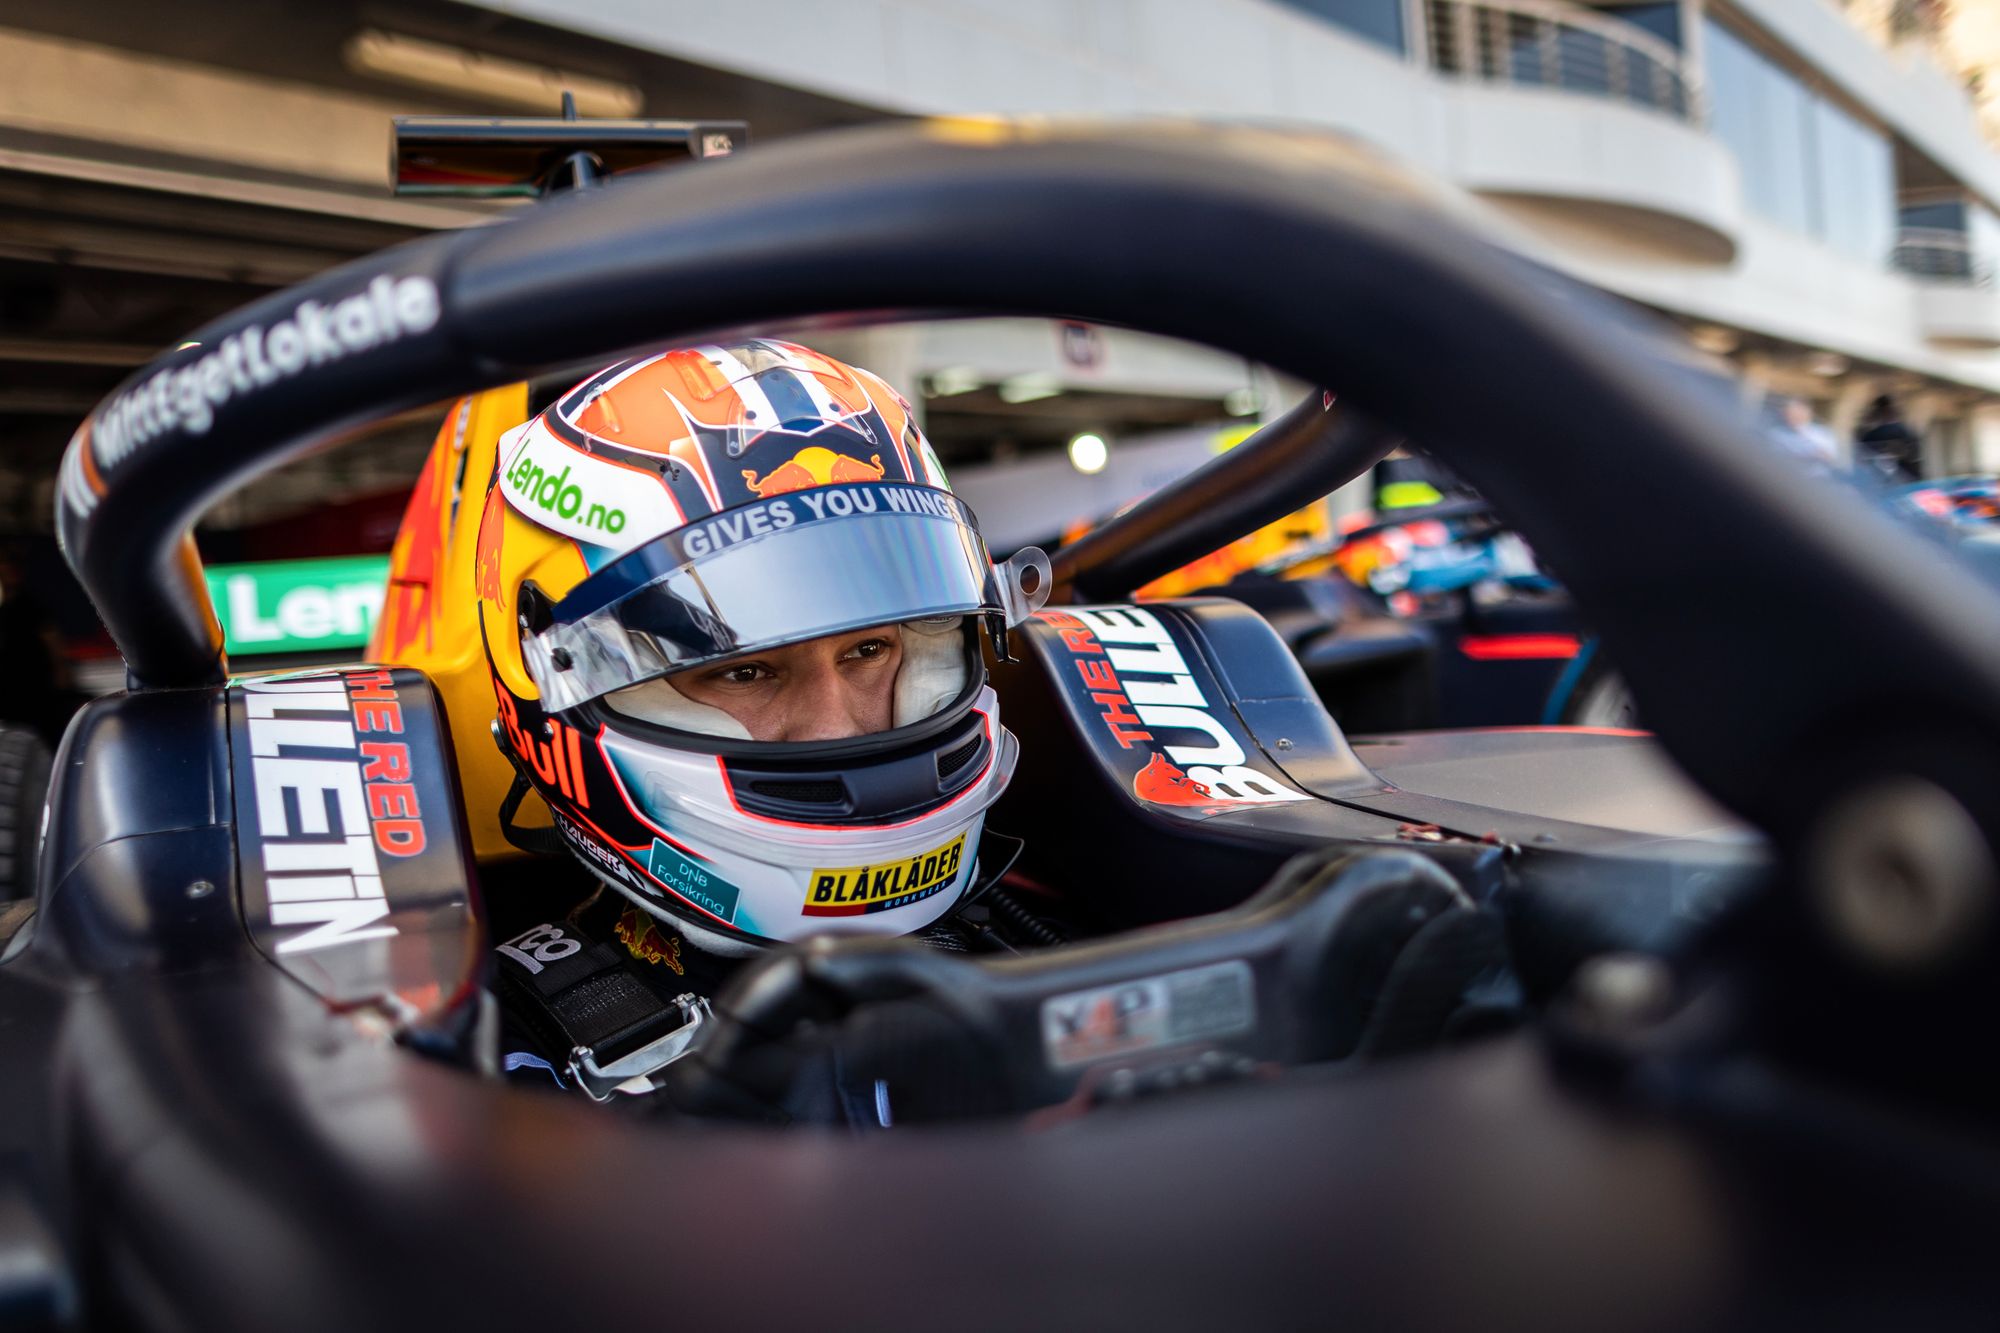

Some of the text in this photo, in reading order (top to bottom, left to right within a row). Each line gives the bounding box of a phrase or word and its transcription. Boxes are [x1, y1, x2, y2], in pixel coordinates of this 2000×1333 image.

[506, 438, 626, 534] Lendo.no
[682, 486, 960, 560] GIVES YOU WINGS
[226, 573, 386, 644] Len
[1030, 611, 1155, 750] THE RE
[1072, 607, 1316, 801] BULLE
[494, 677, 591, 810] Bull
[359, 741, 427, 858] RED
[657, 864, 725, 916] Forsikring
[679, 862, 708, 888] DNB
[812, 841, 963, 903] BLÅKLÄDER
[883, 880, 946, 909] WORKWEAR
